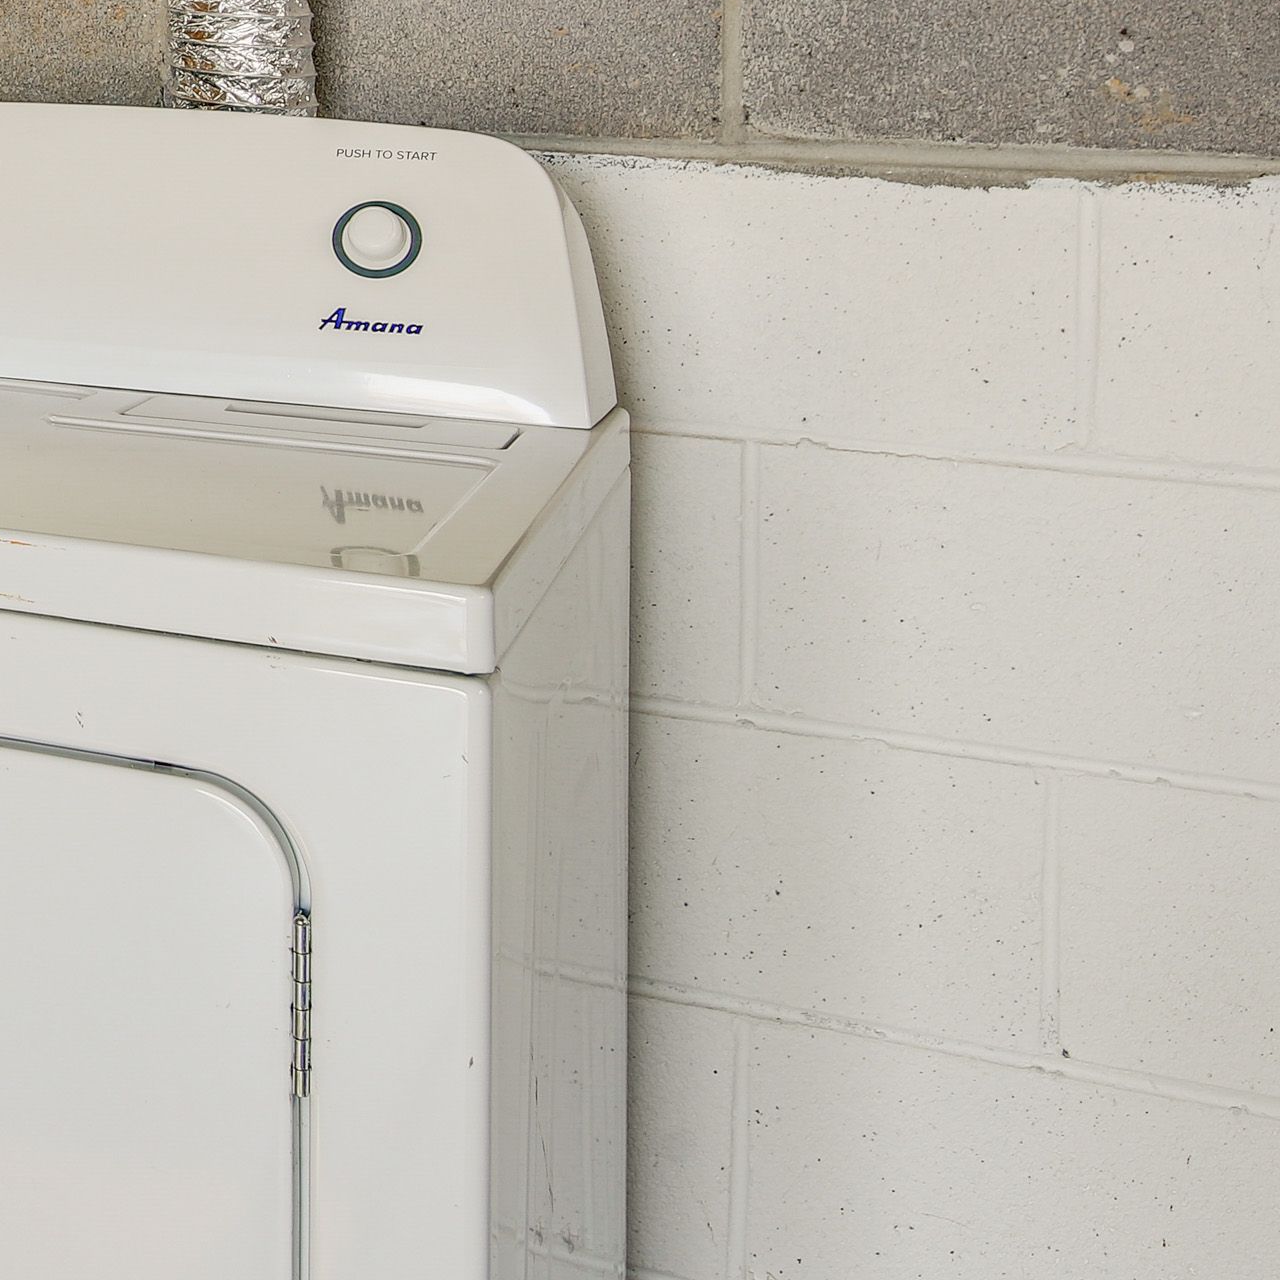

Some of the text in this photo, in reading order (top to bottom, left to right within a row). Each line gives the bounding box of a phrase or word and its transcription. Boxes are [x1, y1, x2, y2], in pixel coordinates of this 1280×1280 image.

[336, 148, 438, 161] PUSH TO START
[319, 307, 424, 335] Amana
